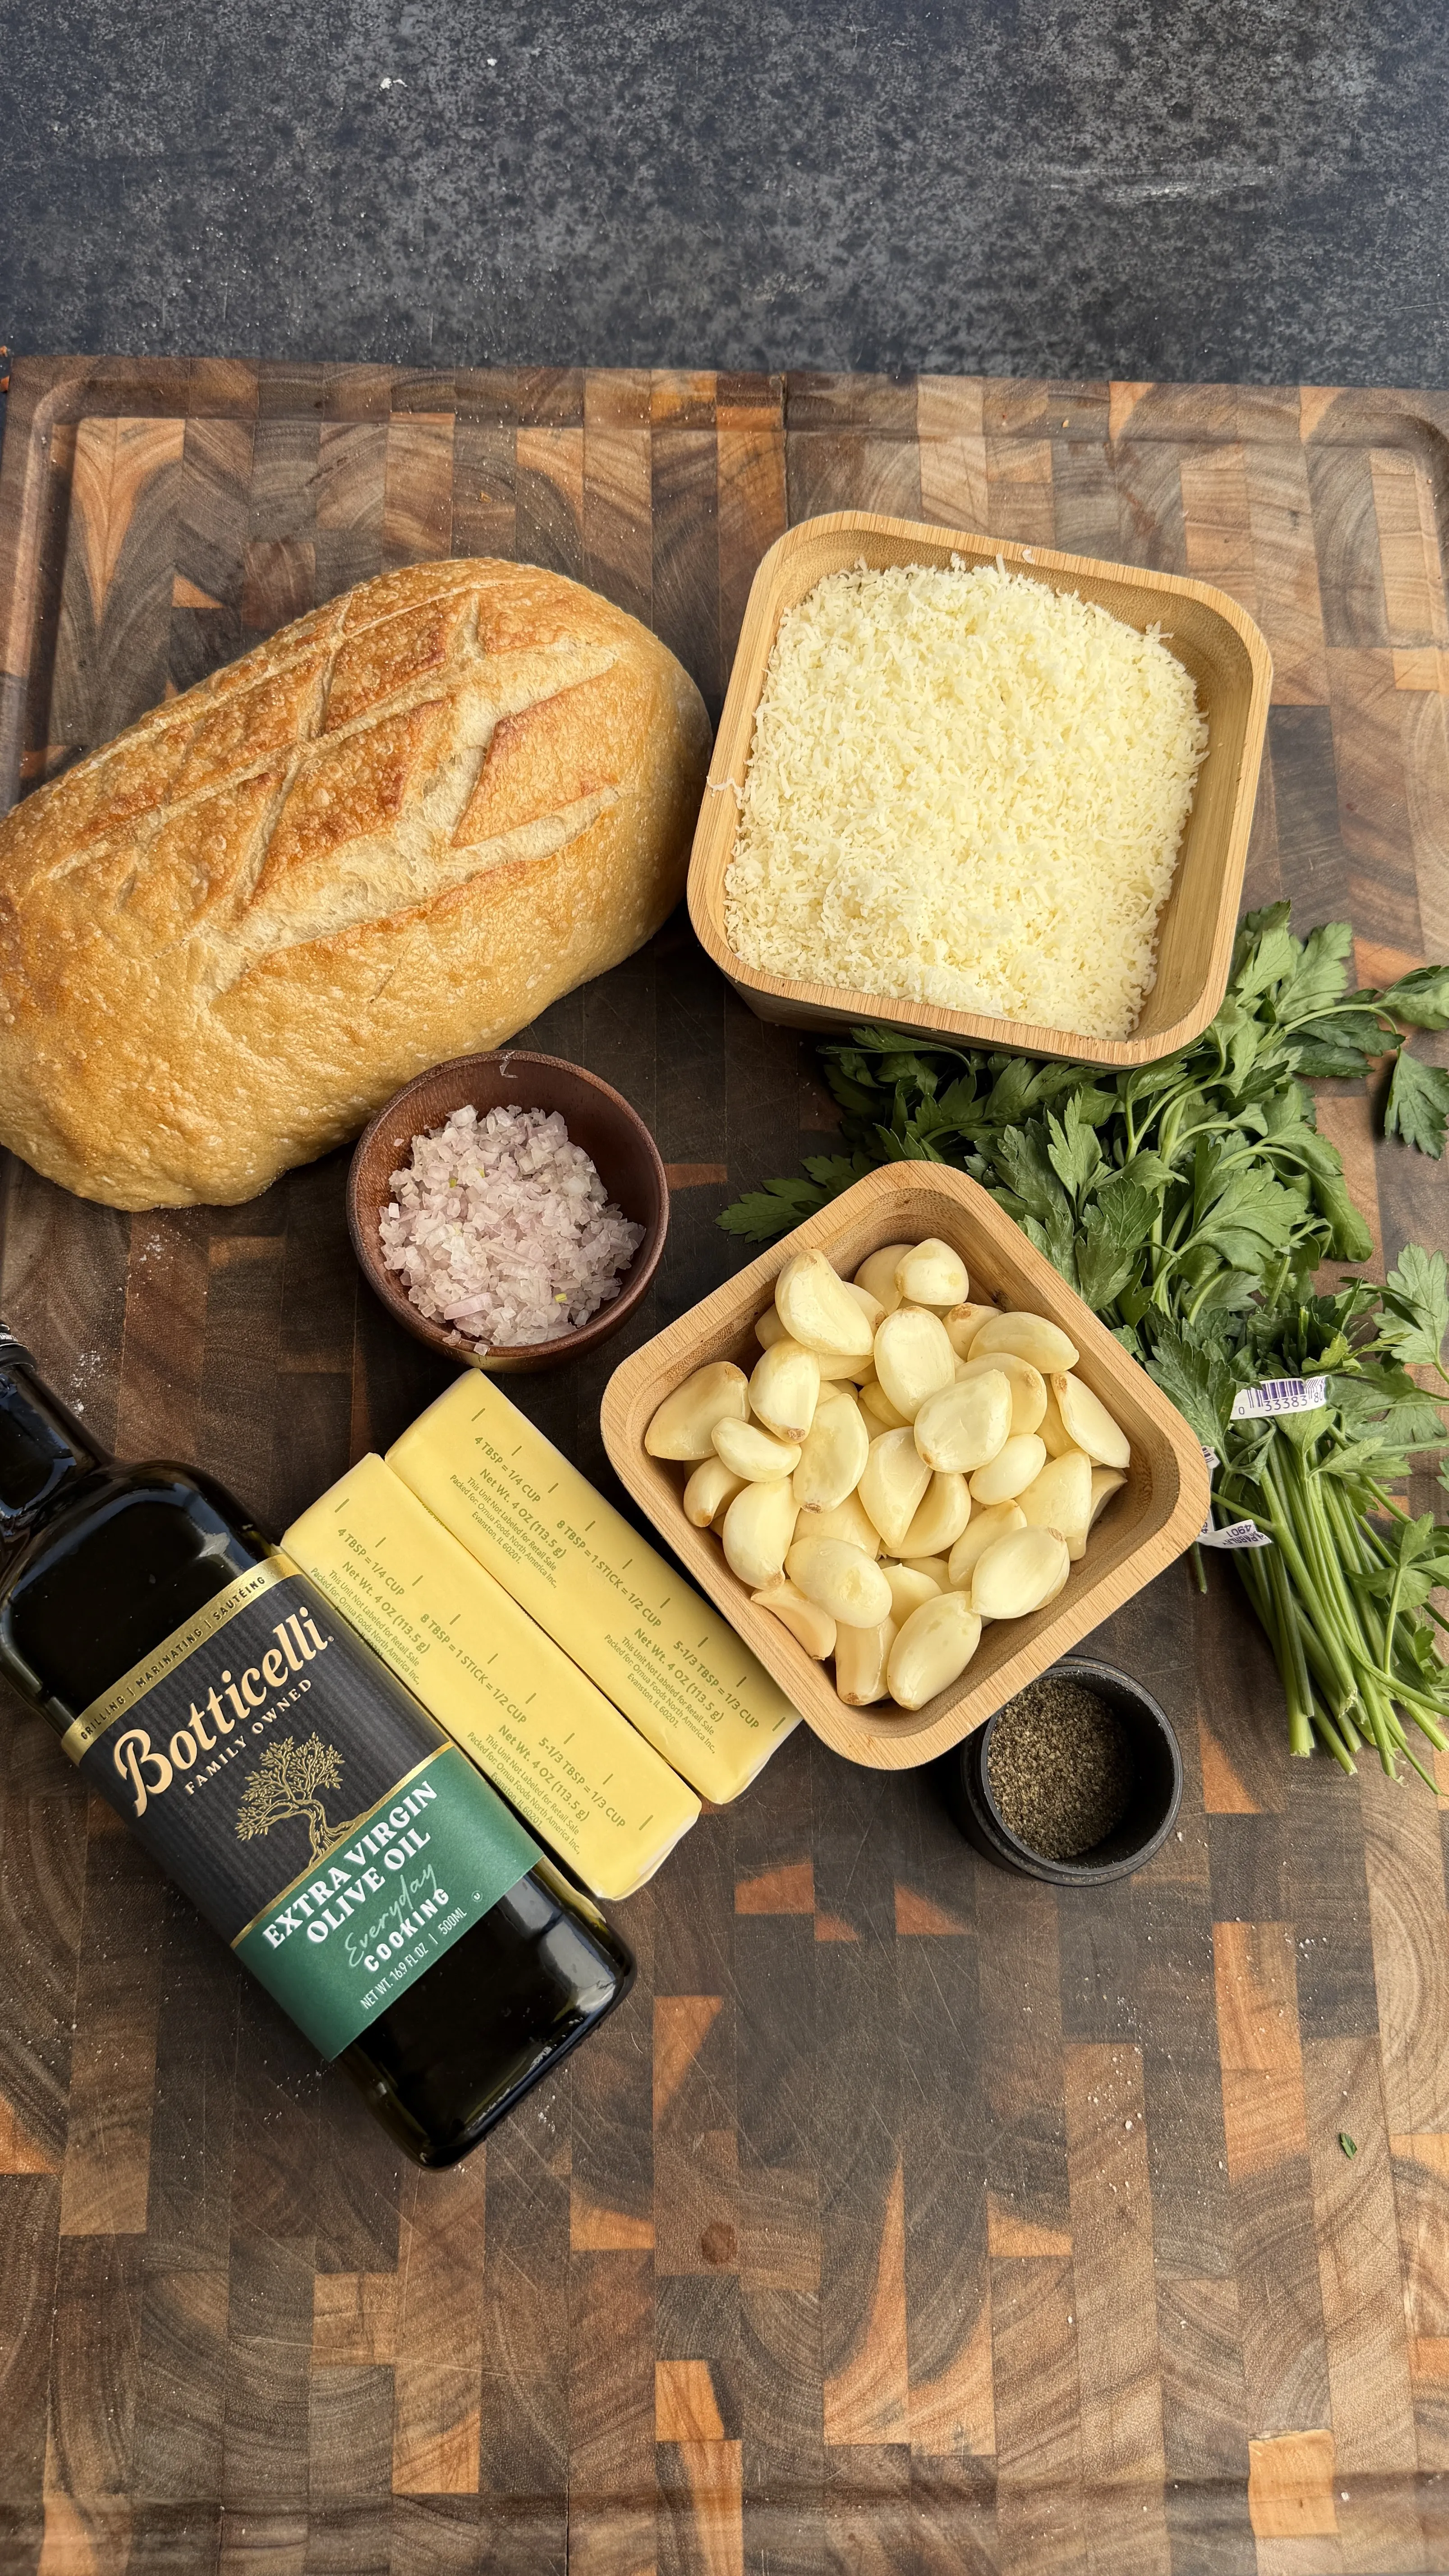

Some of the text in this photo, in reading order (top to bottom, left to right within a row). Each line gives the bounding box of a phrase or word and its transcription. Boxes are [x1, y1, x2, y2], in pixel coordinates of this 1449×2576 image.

[1238, 1406, 1245, 1415] 0
[1263, 1394, 1307, 1412] 33383
[479, 1468, 497, 1487] Net
[496, 1483, 510, 1503] Wt.
[518, 1508, 534, 1523] OZ
[529, 1520, 558, 1548] (113.5
[552, 1547, 567, 1559] g)
[481, 1441, 503, 1463] TBSP
[508, 1469, 523, 1486] 1/4
[521, 1484, 541, 1502] CUP
[337, 1528, 347, 1536] 4
[344, 1533, 367, 1555] TBSP
[371, 1561, 386, 1578] 1/4
[385, 1577, 405, 1595] CUP
[449, 1474, 471, 1495] Packed
[467, 1492, 478, 1505] for:
[477, 1502, 495, 1522] Ornua
[493, 1519, 511, 1537] Foods
[508, 1535, 526, 1554] North
[524, 1552, 547, 1576] America
[467, 1476, 557, 1571] This Unit Not Labeled for Retail Sale
[471, 1511, 522, 1564] Evanston, IL 60201.
[556, 1519, 566, 1529] 8
[563, 1525, 586, 1548] TBSP
[591, 1555, 599, 1563] 1
[595, 1561, 624, 1589] STICK
[627, 1592, 644, 1610] 1/2
[641, 1607, 662, 1626] CUP
[1225, 1524, 1251, 1537] 4901
[310, 1567, 332, 1589] Packed
[328, 1586, 340, 1599] for:
[339, 1596, 357, 1617] Ornua
[354, 1613, 373, 1633] Foods
[370, 1629, 388, 1650] North
[386, 1647, 410, 1673] America
[328, 1569, 419, 1666] This Unit Not Labeled for Retail Sale
[342, 1561, 360, 1580] Net
[359, 1577, 373, 1596] Wt.
[381, 1601, 397, 1618] OZ
[392, 1614, 421, 1642] (113.5
[415, 1642, 431, 1654] g)
[80, 1576, 265, 1740] GRILLING MARINATING SAUTÉING
[420, 1613, 430, 1623] 8
[427, 1619, 451, 1643] TBSP
[455, 1649, 463, 1658] 1
[460, 1656, 488, 1684] STICK
[492, 1688, 509, 1706] 1/2
[506, 1703, 527, 1723] CUP
[603, 1633, 626, 1656] Packed
[622, 1653, 634, 1666] for:
[632, 1664, 651, 1684] Ornua
[649, 1681, 667, 1700] Foods
[665, 1697, 683, 1718] North
[681, 1716, 705, 1741] America
[621, 1636, 714, 1735] This Unit Not Labeled for Retail Sale
[627, 1672, 679, 1728] Evanston, IL 60201.
[634, 1627, 724, 1722] Net Wt. 4 OZ (113.5 g)
[672, 1640, 698, 1666] 5-1/3
[696, 1662, 719, 1686] TBSP
[725, 1693, 741, 1710] 1/3
[739, 1708, 759, 1728] CUP
[114, 1606, 328, 1817] Botticelli
[184, 1679, 311, 1794] FAMILY OWNED
[467, 1731, 489, 1754] Packed
[485, 1751, 497, 1765] for:
[496, 1762, 515, 1783] Ornua
[513, 1780, 531, 1800] Foods
[529, 1797, 547, 1818] North
[545, 1815, 570, 1841] America
[485, 1734, 579, 1835] This Unit Not Labeled for Retail Sale
[489, 1771, 543, 1830] Evanston, IL 60201.
[498, 1724, 590, 1822] Net Wt. 4 OZ (113.5 g)
[538, 1736, 564, 1763] 5-1/3
[562, 1761, 585, 1785] TBSP
[591, 1791, 607, 1808] 1/3
[605, 1807, 626, 1827] CUP
[262, 1780, 437, 1948] EXTRA VIRGIN
[306, 1827, 431, 1943] OLIVE OIL
[344, 1863, 437, 1967] Everyday
[360, 1907, 467, 2009] NET WT. 16.9 FL OZ 500ML
[363, 1888, 449, 1972] COOKING
